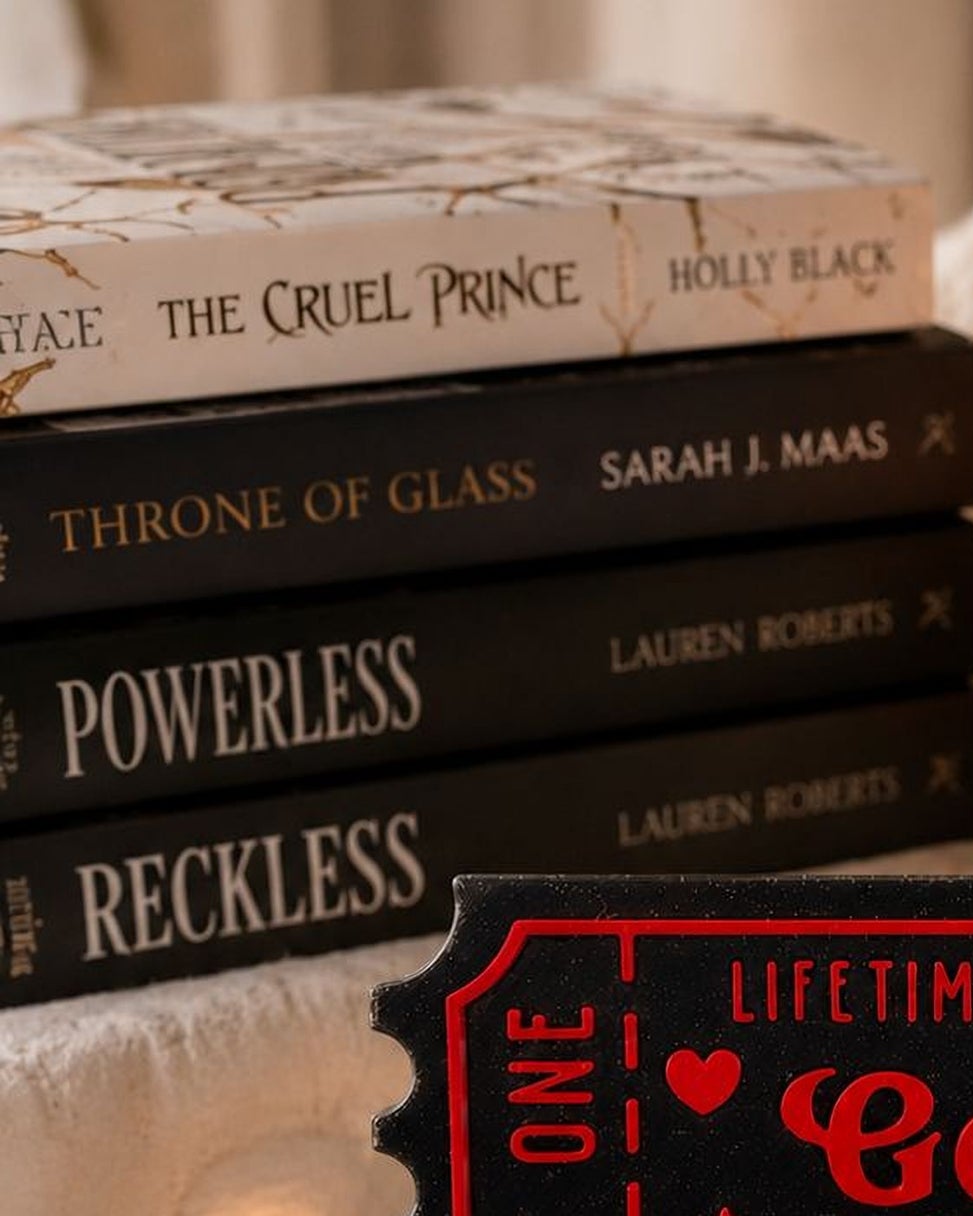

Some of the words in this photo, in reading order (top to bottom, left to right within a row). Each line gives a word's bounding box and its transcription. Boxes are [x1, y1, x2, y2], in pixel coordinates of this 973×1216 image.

[158, 294, 245, 340] THE
[263, 272, 410, 343] CRUEL
[415, 254, 581, 329] PRINCE
[669, 248, 777, 293] HOLLY
[790, 239, 895, 283] BLACK
[601, 439, 732, 491] SARAH
[746, 441, 769, 476] J.
[781, 420, 889, 469] MAAS
[49, 485, 286, 552] THRONE
[304, 476, 371, 524] OF
[388, 458, 538, 514] GLASS
[610, 620, 745, 674] LAUREN
[758, 600, 893, 653] ROBERTS
[56, 634, 422, 779] POWERLESS
[618, 791, 751, 847] LAUREN
[765, 766, 901, 820] ROBERTS
[74, 811, 426, 962] RECKLESS
[505, 1003, 598, 1166] ONE
